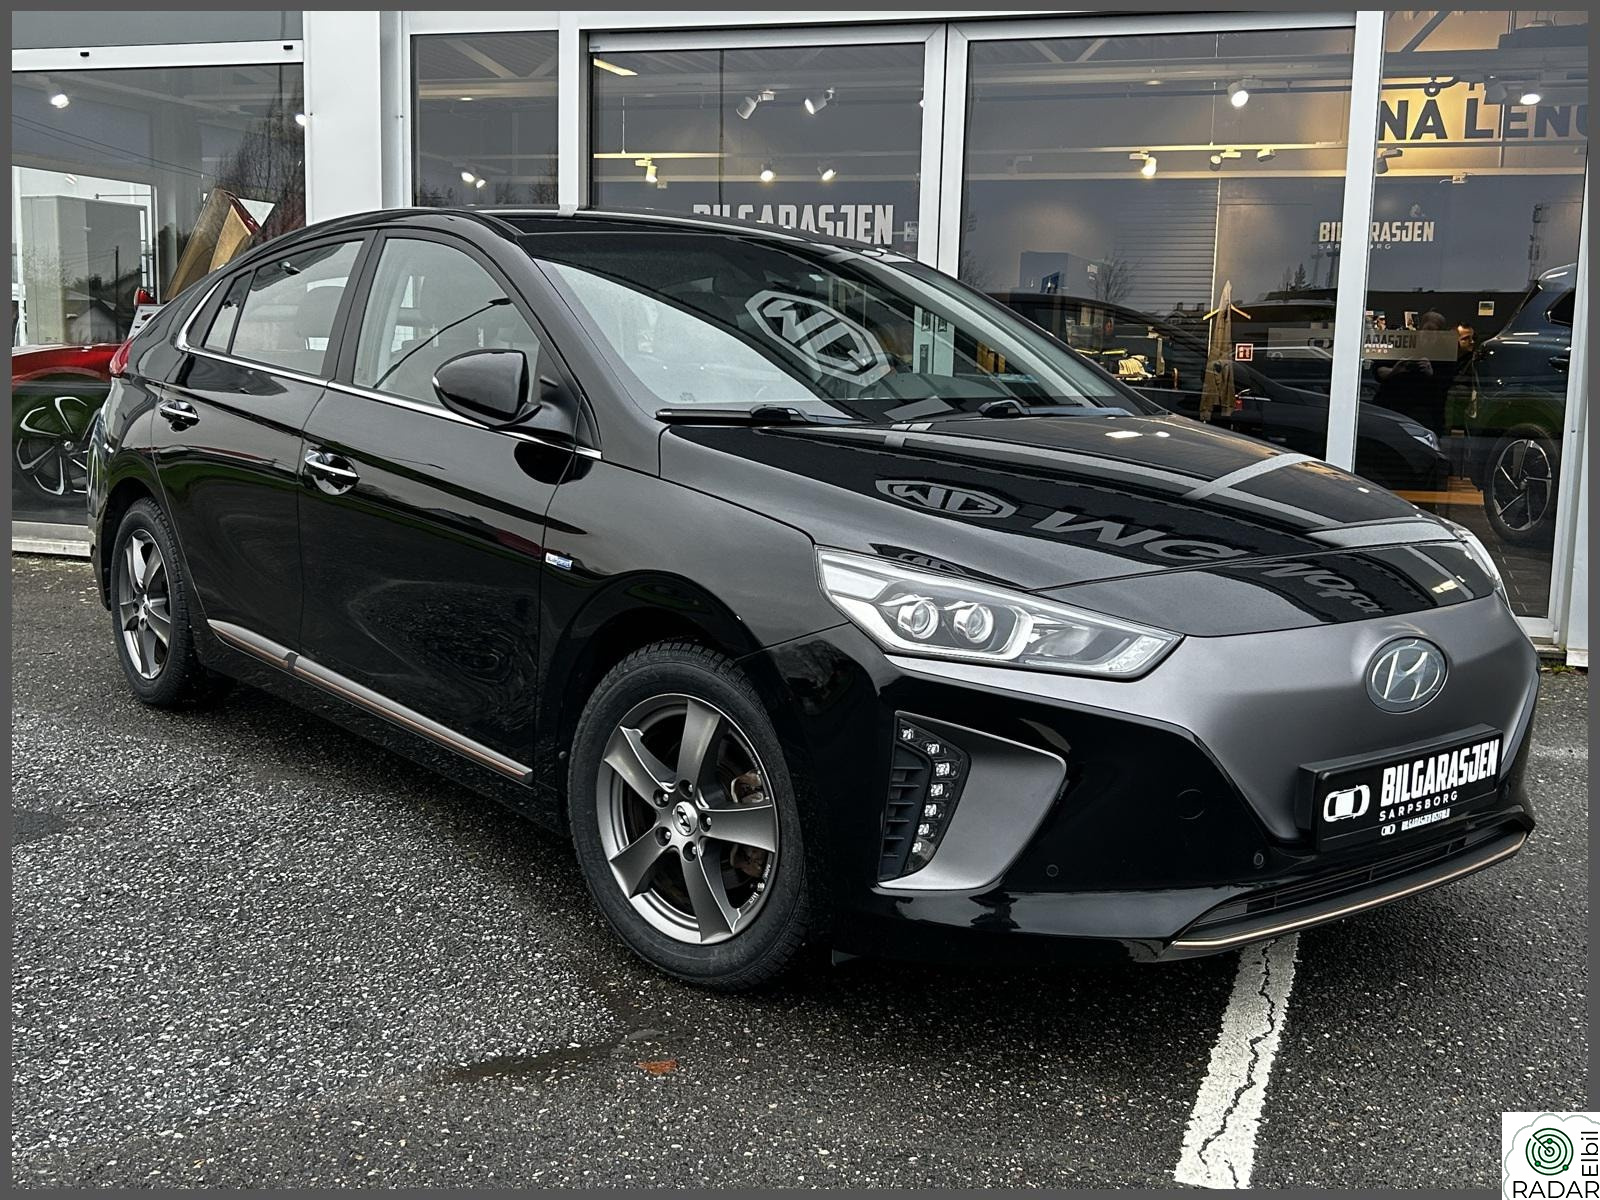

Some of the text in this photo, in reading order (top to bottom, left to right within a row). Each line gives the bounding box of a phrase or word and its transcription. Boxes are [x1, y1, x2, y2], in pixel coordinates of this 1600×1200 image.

[693, 204, 893, 245] RASJEN
[1319, 222, 1434, 241] BIRASJEN
[1380, 739, 1500, 807] BILGARASJEN
[1379, 791, 1458, 822] SARPSBORG
